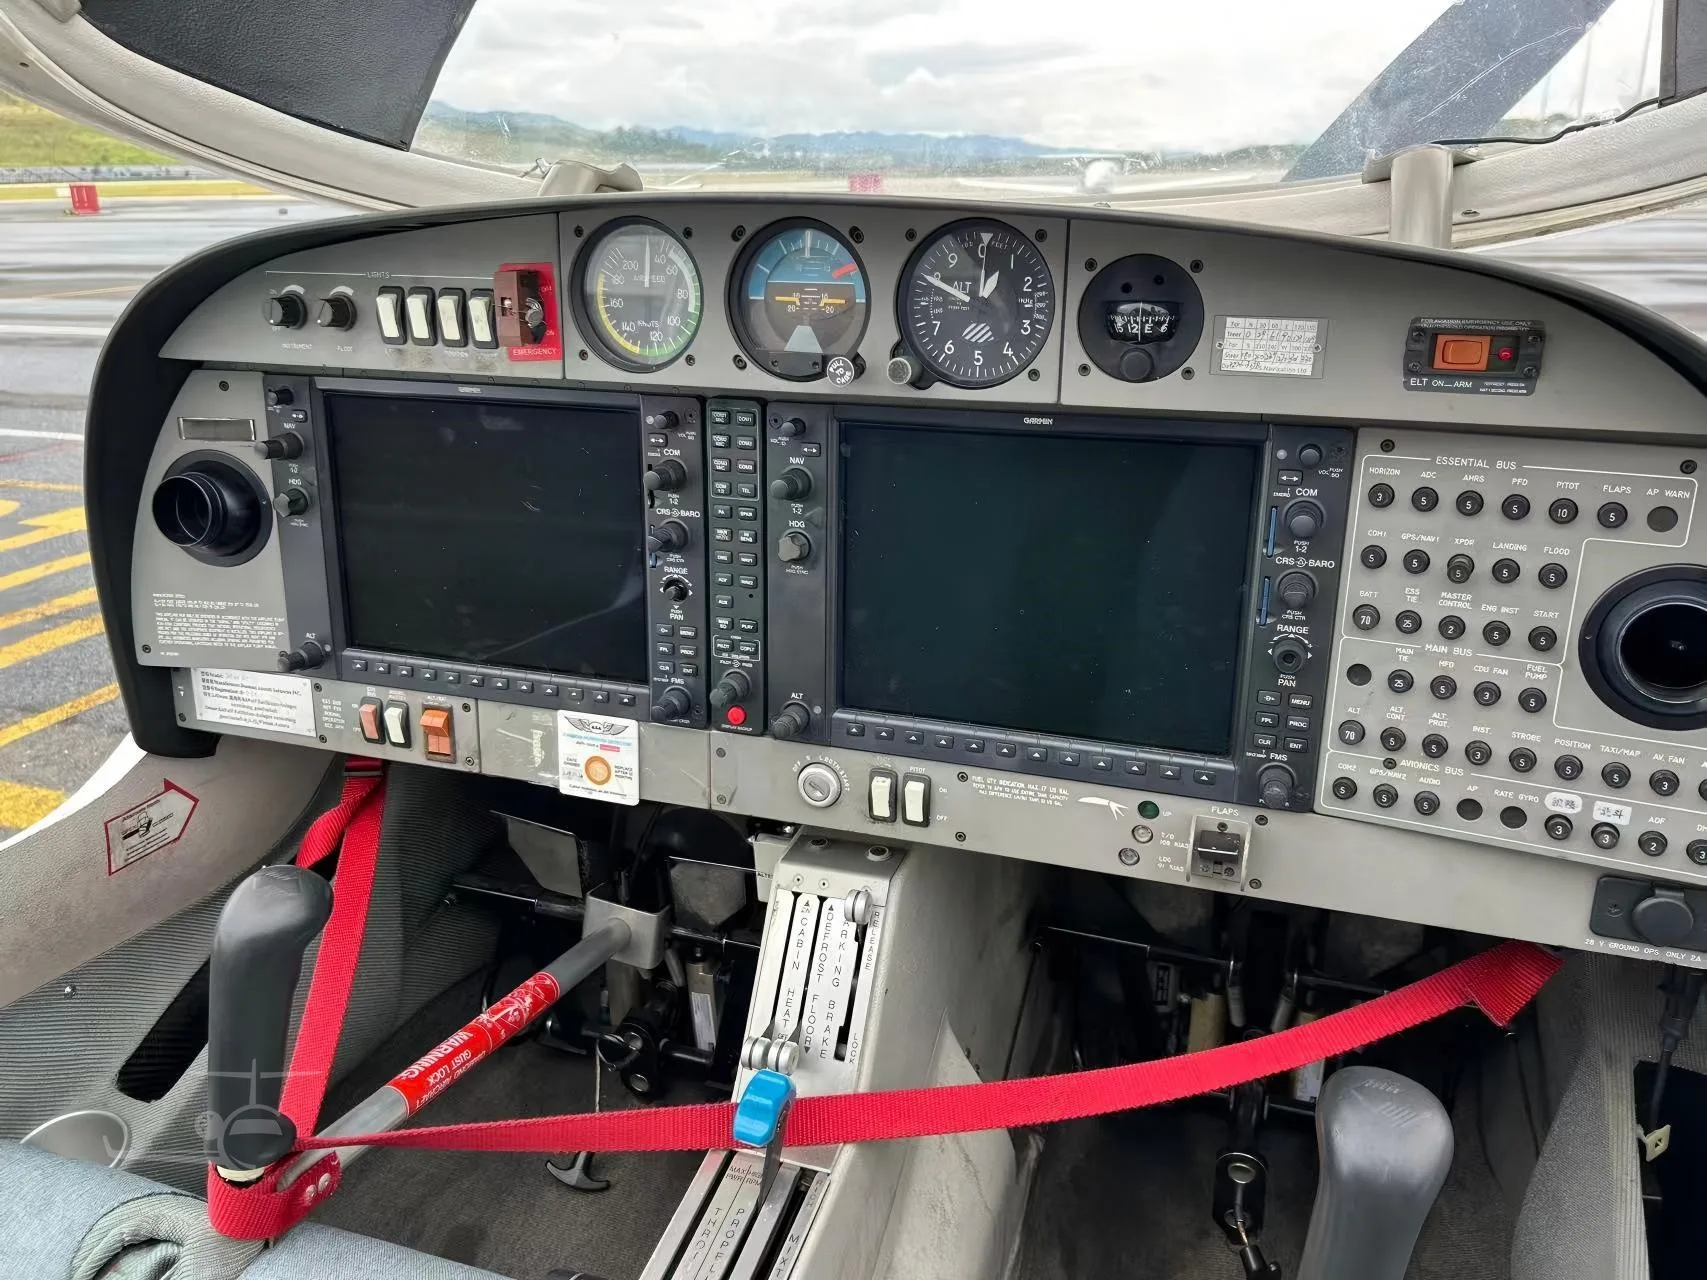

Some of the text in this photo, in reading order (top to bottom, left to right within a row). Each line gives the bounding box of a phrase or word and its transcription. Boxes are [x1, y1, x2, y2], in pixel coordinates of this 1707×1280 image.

[978, 244, 986, 258] 0
[654, 254, 666, 264] 40
[948, 253, 958, 268] 9
[1010, 254, 1014, 270] 1
[623, 260, 638, 270] 200
[666, 265, 678, 276] 60
[952, 282, 972, 293] ALT
[1023, 277, 1032, 292] 2
[677, 289, 688, 300] 80
[610, 298, 624, 308] 160
[668, 316, 680, 326] 100
[622, 322, 636, 332] 140
[932, 321, 940, 336] 7
[1021, 320, 1030, 334] 3
[1128, 322, 1168, 333] 12 E 6
[650, 332, 664, 342] 120
[512, 348, 557, 356] EMERGENCY
[944, 340, 954, 354] 6
[1003, 342, 1013, 356] 4
[974, 351, 983, 365] 5
[830, 360, 844, 372] PULL
[835, 366, 845, 376] TO
[1410, 378, 1428, 386] ELT
[1432, 379, 1445, 387] ON
[1435, 456, 1516, 470] ESSENTIAL BUS
[1369, 467, 1400, 476] HORIZON
[1462, 474, 1484, 482] AHRS
[1556, 481, 1579, 490] PITOT
[1603, 485, 1631, 494] FLAPS
[1296, 488, 1318, 496] COM
[1665, 490, 1690, 499] WARN
[1558, 508, 1568, 518] 10
[1401, 532, 1440, 543] GPS/NAV1
[1492, 542, 1527, 552] LANDING
[1543, 546, 1570, 556] FLOOD
[1276, 556, 1335, 568] CRS BARO
[1441, 592, 1472, 601] MASTER
[1438, 599, 1472, 609] CONTROL
[1482, 604, 1519, 614] ENG INST
[1534, 610, 1559, 619] START
[1360, 615, 1370, 625] 70
[1403, 619, 1412, 628] 25
[1277, 625, 1308, 634] RANGE
[1395, 647, 1414, 656] MAIN
[1425, 644, 1472, 657] MAIN BUS
[1438, 660, 1454, 668] MFD
[1526, 664, 1547, 673] FUEL
[1474, 665, 1508, 676] CDU FAN
[1525, 672, 1547, 681] PUMP
[1278, 679, 1296, 687] PAN
[1394, 679, 1404, 687] 25
[1386, 712, 1407, 721] CONT.
[1432, 712, 1448, 721] ALT.
[1428, 720, 1450, 728] PROT.
[1345, 730, 1355, 740] 70
[1472, 726, 1492, 734] INST.
[1511, 731, 1541, 742] STROBE
[1554, 738, 1591, 750] POSITION
[1600, 745, 1640, 757] TAXI/MAP
[1653, 753, 1686, 764] AV. FAN
[824, 757, 841, 772] BOTH
[1400, 759, 1464, 776] AVIONICS BUS
[1420, 776, 1441, 786] AUDIO
[1494, 789, 1538, 803] RATE GYRO
[1211, 806, 1238, 816] FLAPS
[865, 912, 880, 970] RELEASE
[1609, 942, 1639, 952] GROUND
[1644, 947, 1659, 955] OPS
[1666, 951, 1685, 960] ONLY
[783, 918, 808, 1028] CABIN HEAT
[805, 912, 834, 1046] DEFROST FLOOR
[820, 920, 850, 1058] ARKING BRAKE
[850, 1034, 858, 1064] LOCK
[402, 1032, 473, 1080] WARNING
[427, 1049, 472, 1086] GUST LOCK
[730, 1166, 745, 1174] MAX
[725, 1174, 743, 1182] PWR
[776, 1234, 800, 1278] MIXT
